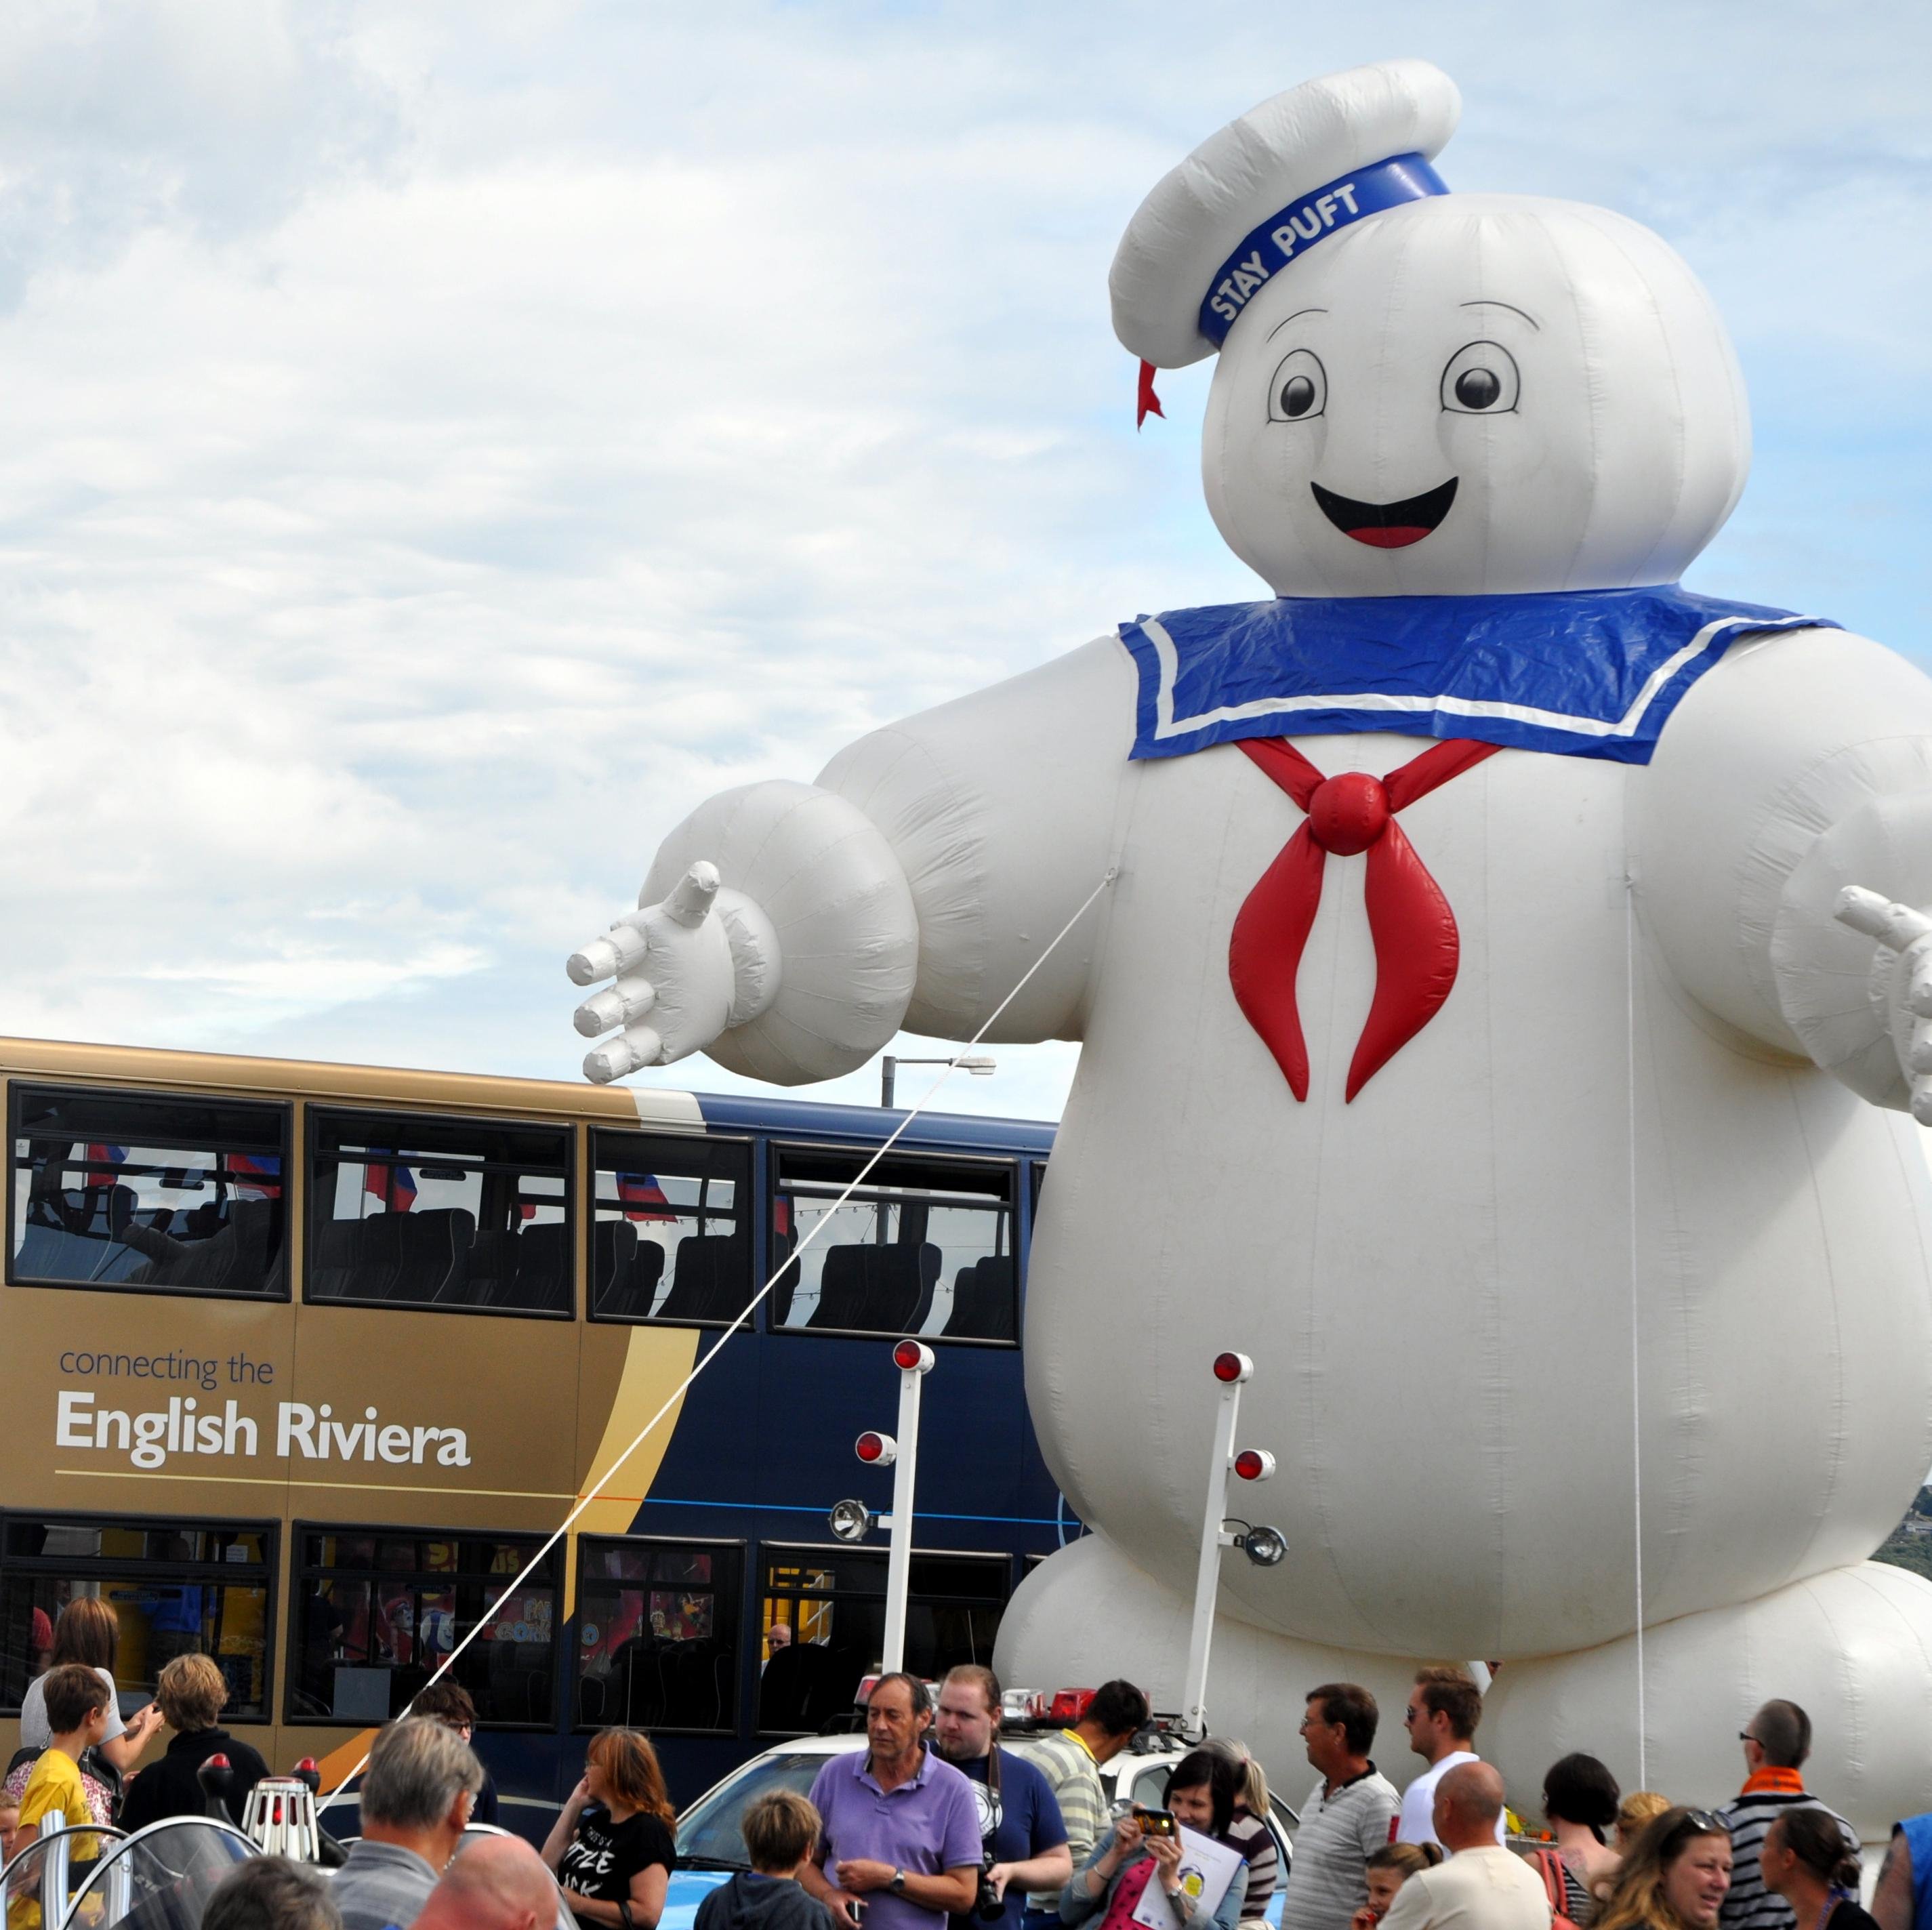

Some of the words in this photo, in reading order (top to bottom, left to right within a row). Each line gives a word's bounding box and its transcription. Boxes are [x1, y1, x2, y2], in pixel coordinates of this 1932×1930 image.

[1210, 251, 1269, 321] STAY
[1271, 183, 1359, 257] PUFT
[60, 1349, 218, 1390] connecting
[227, 1353, 273, 1384] the
[56, 1390, 258, 1469] English
[276, 1401, 471, 1466] Riviera
